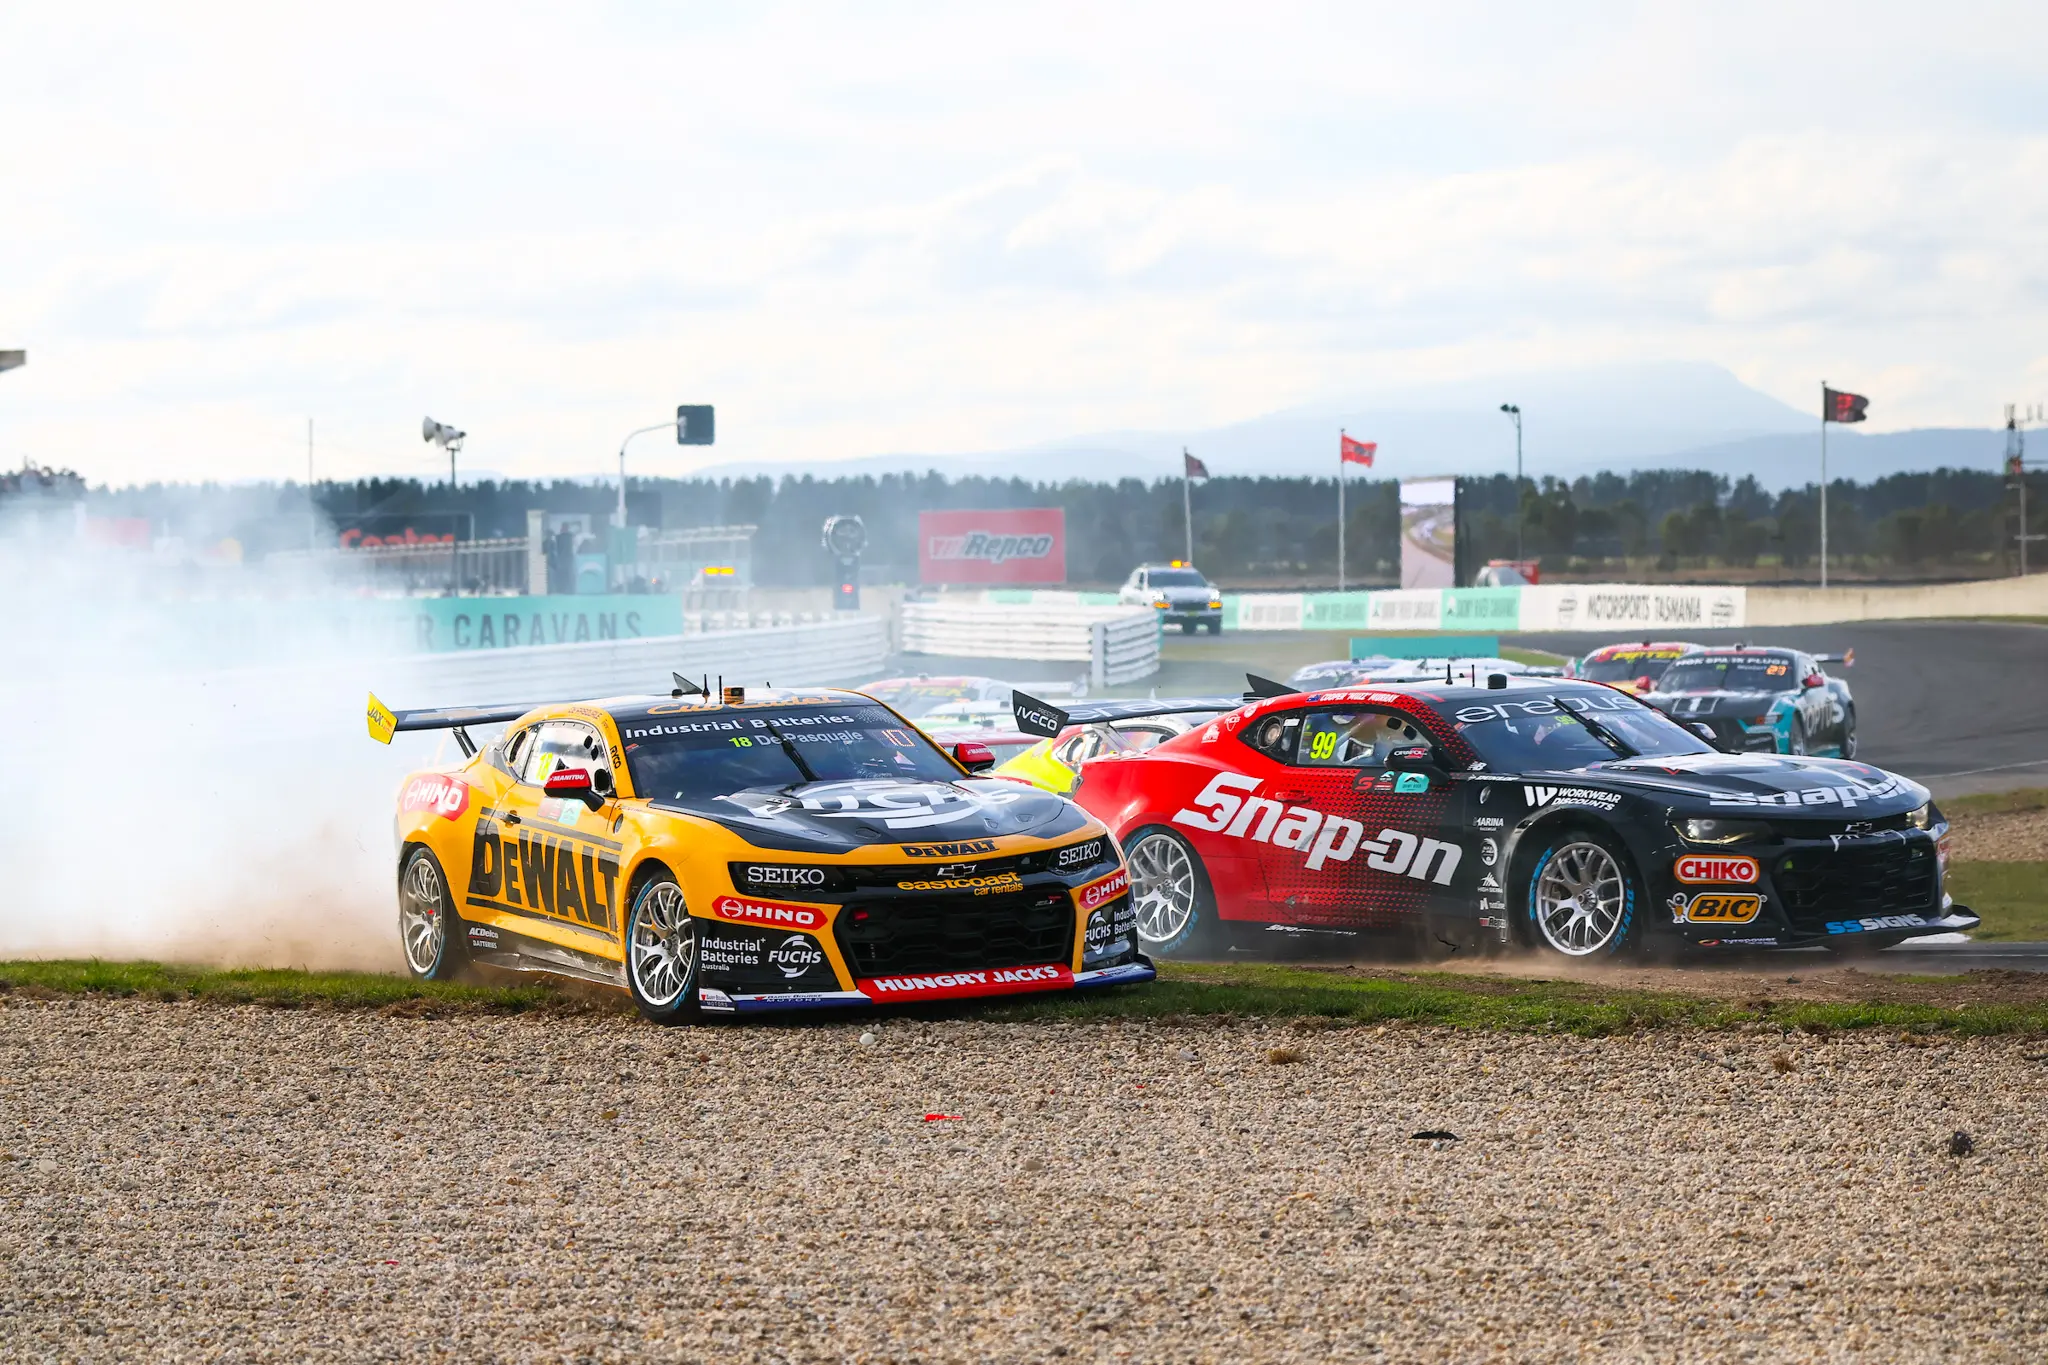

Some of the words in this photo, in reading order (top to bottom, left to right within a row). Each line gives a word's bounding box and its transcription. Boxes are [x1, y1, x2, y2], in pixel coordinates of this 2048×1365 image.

[964, 533, 1051, 560] Repco
[1588, 594, 1650, 620] MOTORSPORTS
[1654, 595, 1702, 621] TASMANIA
[454, 611, 643, 649] CARAVANS
[367, 707, 385, 726] JAX
[750, 713, 855, 730] Batteries
[1016, 706, 1058, 731] IVECO
[729, 737, 753, 748] 18
[754, 734, 782, 746] De
[784, 729, 864, 744] Pasquale
[1310, 731, 1338, 760] 99
[609, 745, 622, 769] RYCO
[552, 774, 586, 782] MANITOU
[419, 784, 463, 812] HINO
[1553, 797, 1616, 811] DISCOUNTS
[1559, 787, 1622, 804] WORKWEAR
[1171, 770, 1463, 887] Snap-on
[1058, 841, 1101, 867] SEIKO
[747, 865, 825, 885] SEIKO
[1680, 860, 1753, 881] CHIKO
[897, 871, 1022, 892] eastcoast
[973, 886, 990, 896] car
[991, 882, 1024, 895] rentals
[745, 906, 815, 925] HINO
[469, 927, 499, 939] ACDelco
[1084, 923, 1112, 942] FUCHS
[472, 940, 497, 949] BATTERIES
[701, 950, 759, 965] Batteries
[768, 950, 822, 964] FUCHS
[701, 963, 730, 972] Australia
[872, 972, 988, 993] HUNGRY
[992, 964, 1060, 983] JACK'S
